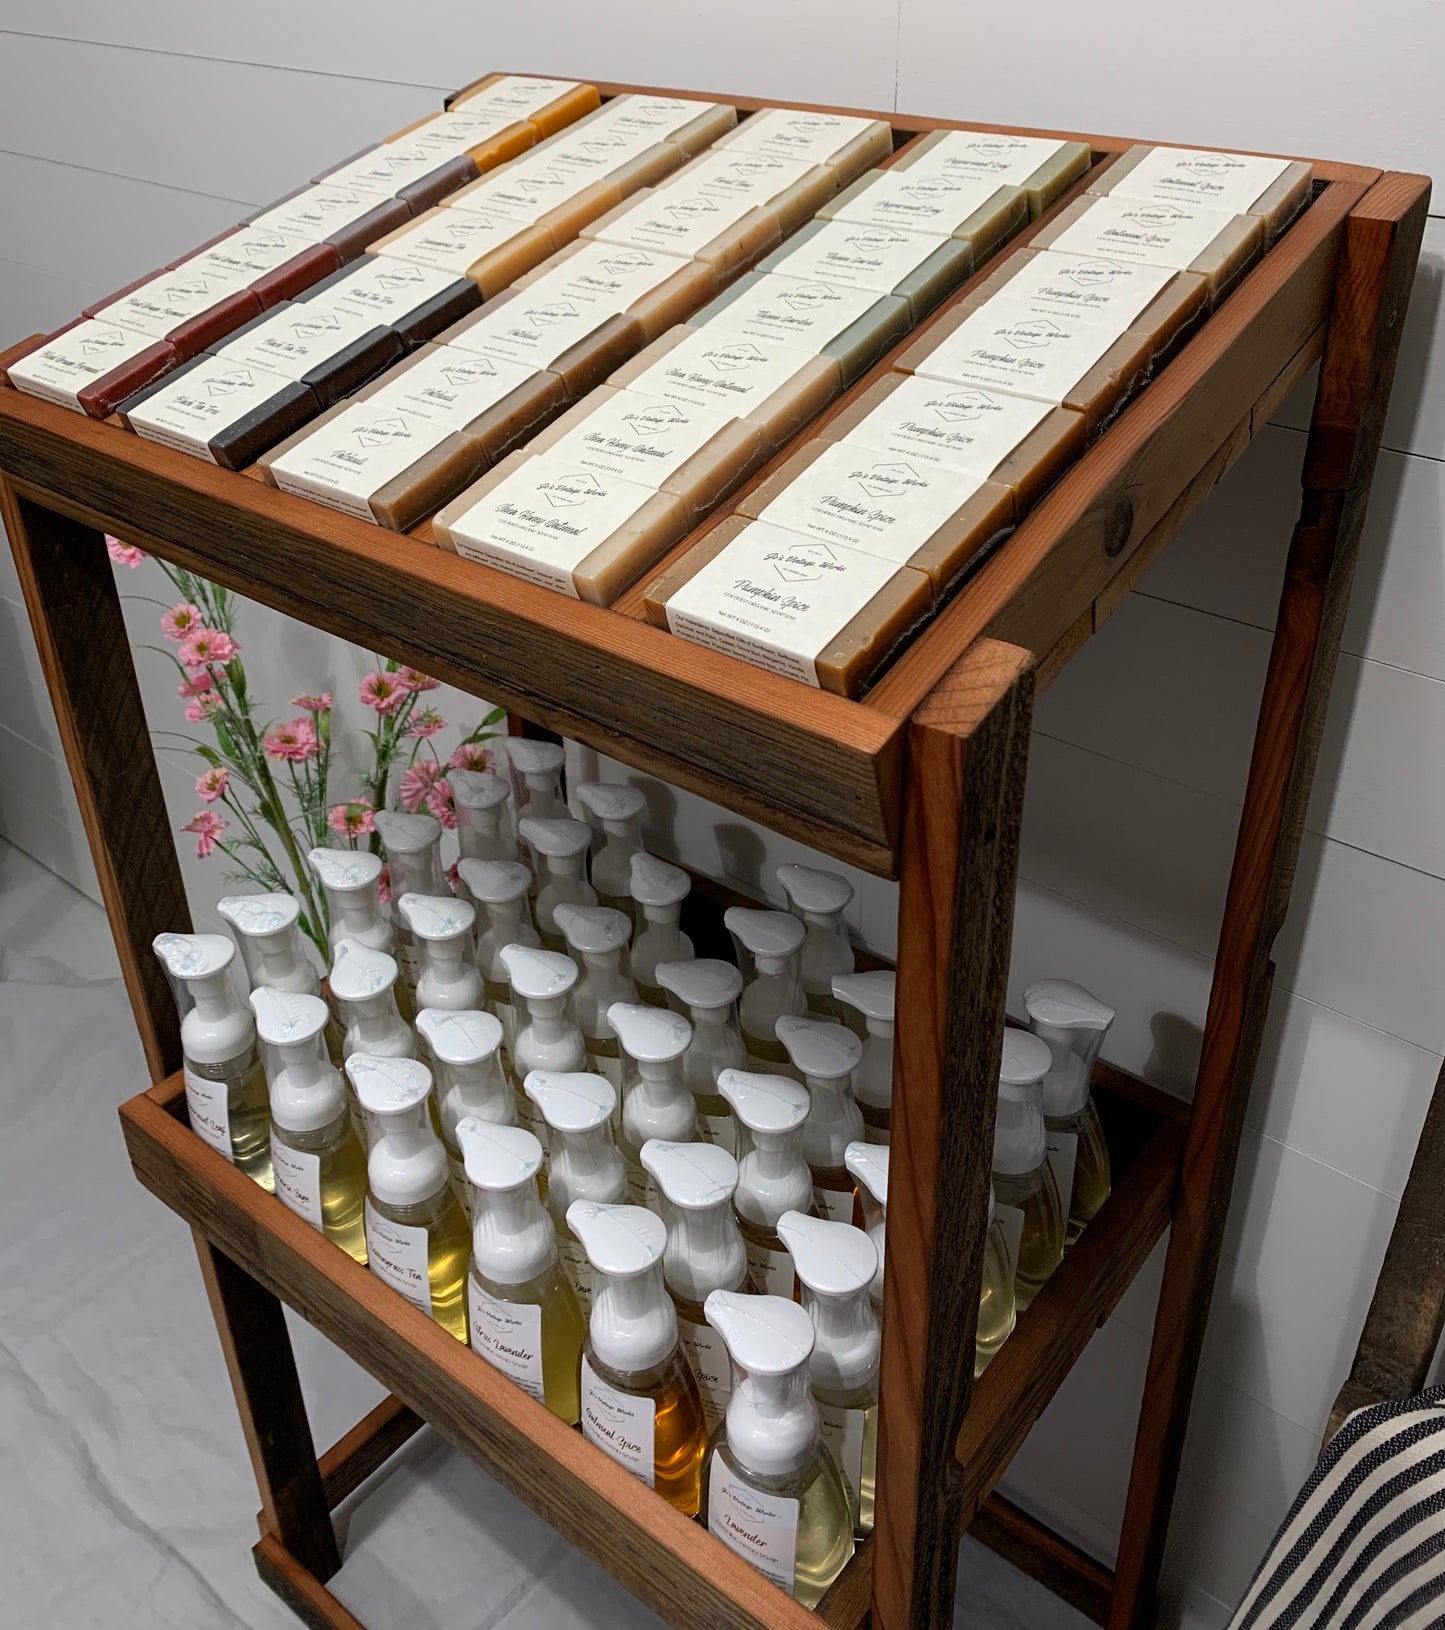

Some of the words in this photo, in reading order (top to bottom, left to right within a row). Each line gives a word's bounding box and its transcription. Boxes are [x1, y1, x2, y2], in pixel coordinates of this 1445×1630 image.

[1038, 287, 1082, 301] Pumpkin
[1084, 292, 1110, 303] Spice
[1014, 330, 1042, 338] Vintage
[1045, 332, 1072, 340] Works
[970, 349, 1016, 364] Pumpkin
[1018, 358, 1045, 370] Spice
[688, 371, 714, 386] Honey
[712, 378, 754, 394] Oatmeal
[944, 402, 974, 410] Vintage
[977, 402, 1004, 411] Works
[899, 422, 946, 438] Pumpkin
[947, 432, 974, 445] Spice
[583, 432, 604, 443] Shea
[606, 436, 632, 452] Honey
[632, 444, 674, 459] Oatmeal
[848, 471, 868, 479] Jo's
[869, 474, 898, 485] Vintage
[902, 478, 930, 488] Works
[536, 482, 555, 492] Jo's
[555, 484, 581, 494] Vintage
[584, 488, 608, 498] Works
[494, 503, 518, 516] Shea
[518, 510, 546, 527] Honey
[545, 518, 588, 536] Oatmeal
[821, 495, 866, 516] Pumpkin
[868, 509, 896, 524] Spice
[764, 552, 784, 561] Jo's
[785, 556, 815, 567] Vintage
[819, 561, 847, 571] Works
[733, 579, 781, 601] Pumpkin
[782, 596, 810, 612] Spice
[405, 1268, 422, 1280] Tea
[486, 1311, 502, 1322] Vintage
[472, 1321, 492, 1344] Citrus
[493, 1338, 534, 1360] Lavender
[694, 1368, 720, 1384] Spice
[598, 1397, 614, 1410] Vintage
[617, 1408, 634, 1417] Works
[586, 1408, 616, 1438] Oatmeal
[617, 1436, 642, 1453] Spice
[824, 1420, 842, 1429] Works
[732, 1496, 752, 1510] Vintage
[756, 1508, 776, 1518] Works
[724, 1514, 768, 1548] Lavender
